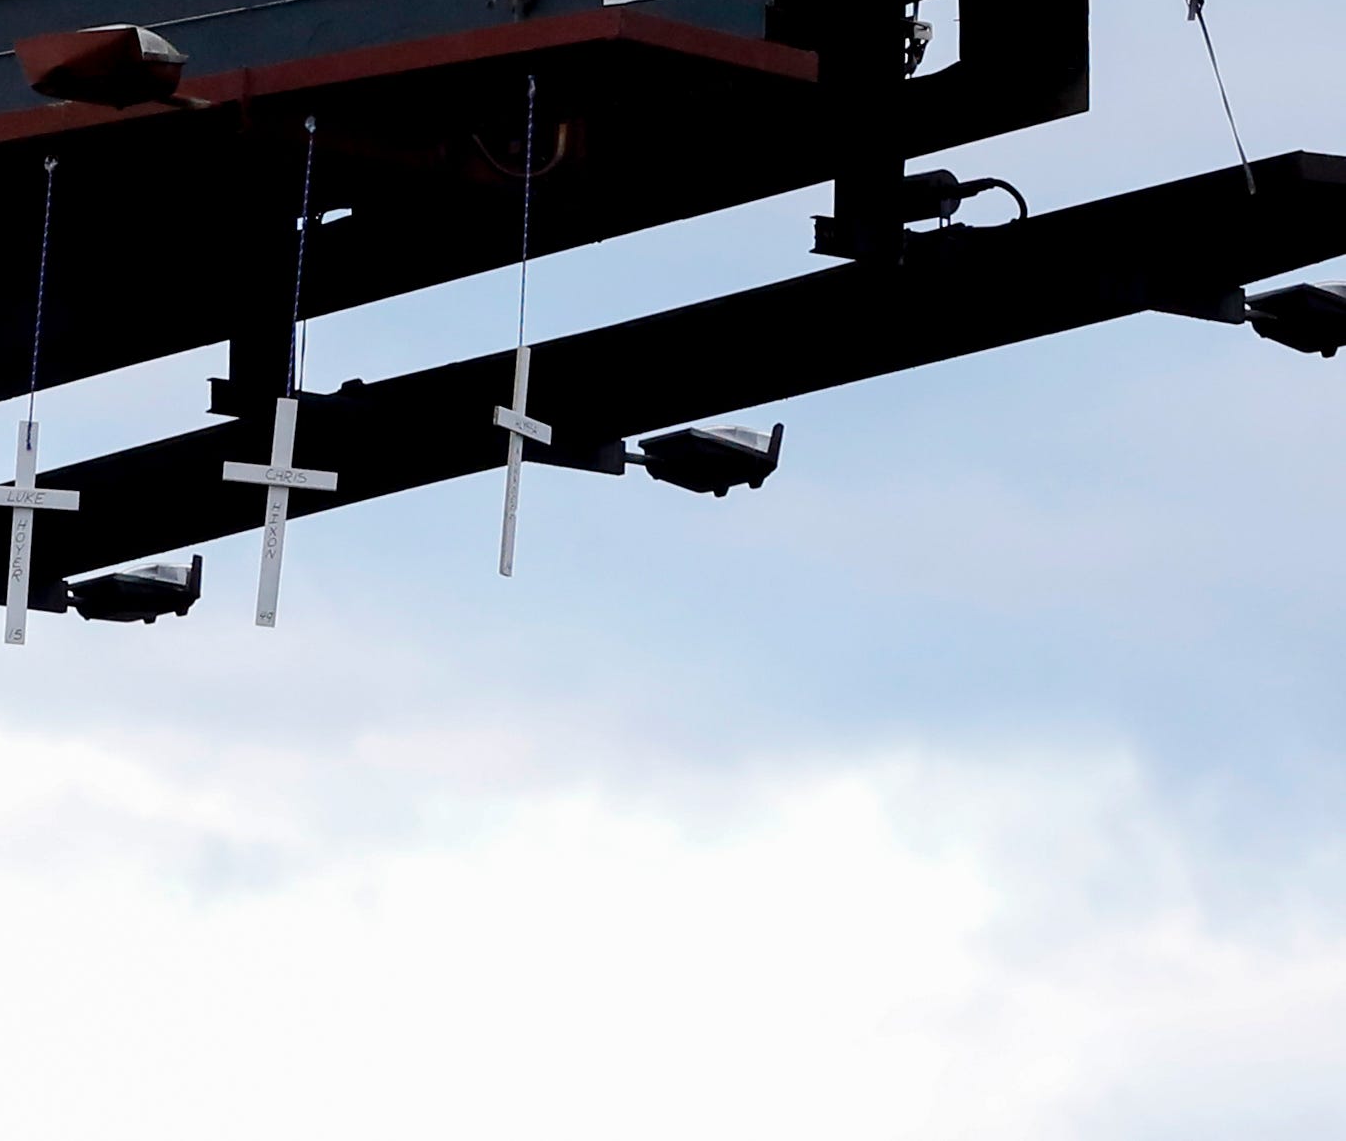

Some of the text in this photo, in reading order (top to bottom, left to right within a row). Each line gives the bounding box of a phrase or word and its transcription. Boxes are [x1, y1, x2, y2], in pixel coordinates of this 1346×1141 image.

[264, 467, 308, 485] CHRIS
[6, 490, 47, 506] LUKE
[264, 501, 282, 560] HIXON
[11, 519, 29, 583] HOYER
[8, 628, 23, 642] 15
